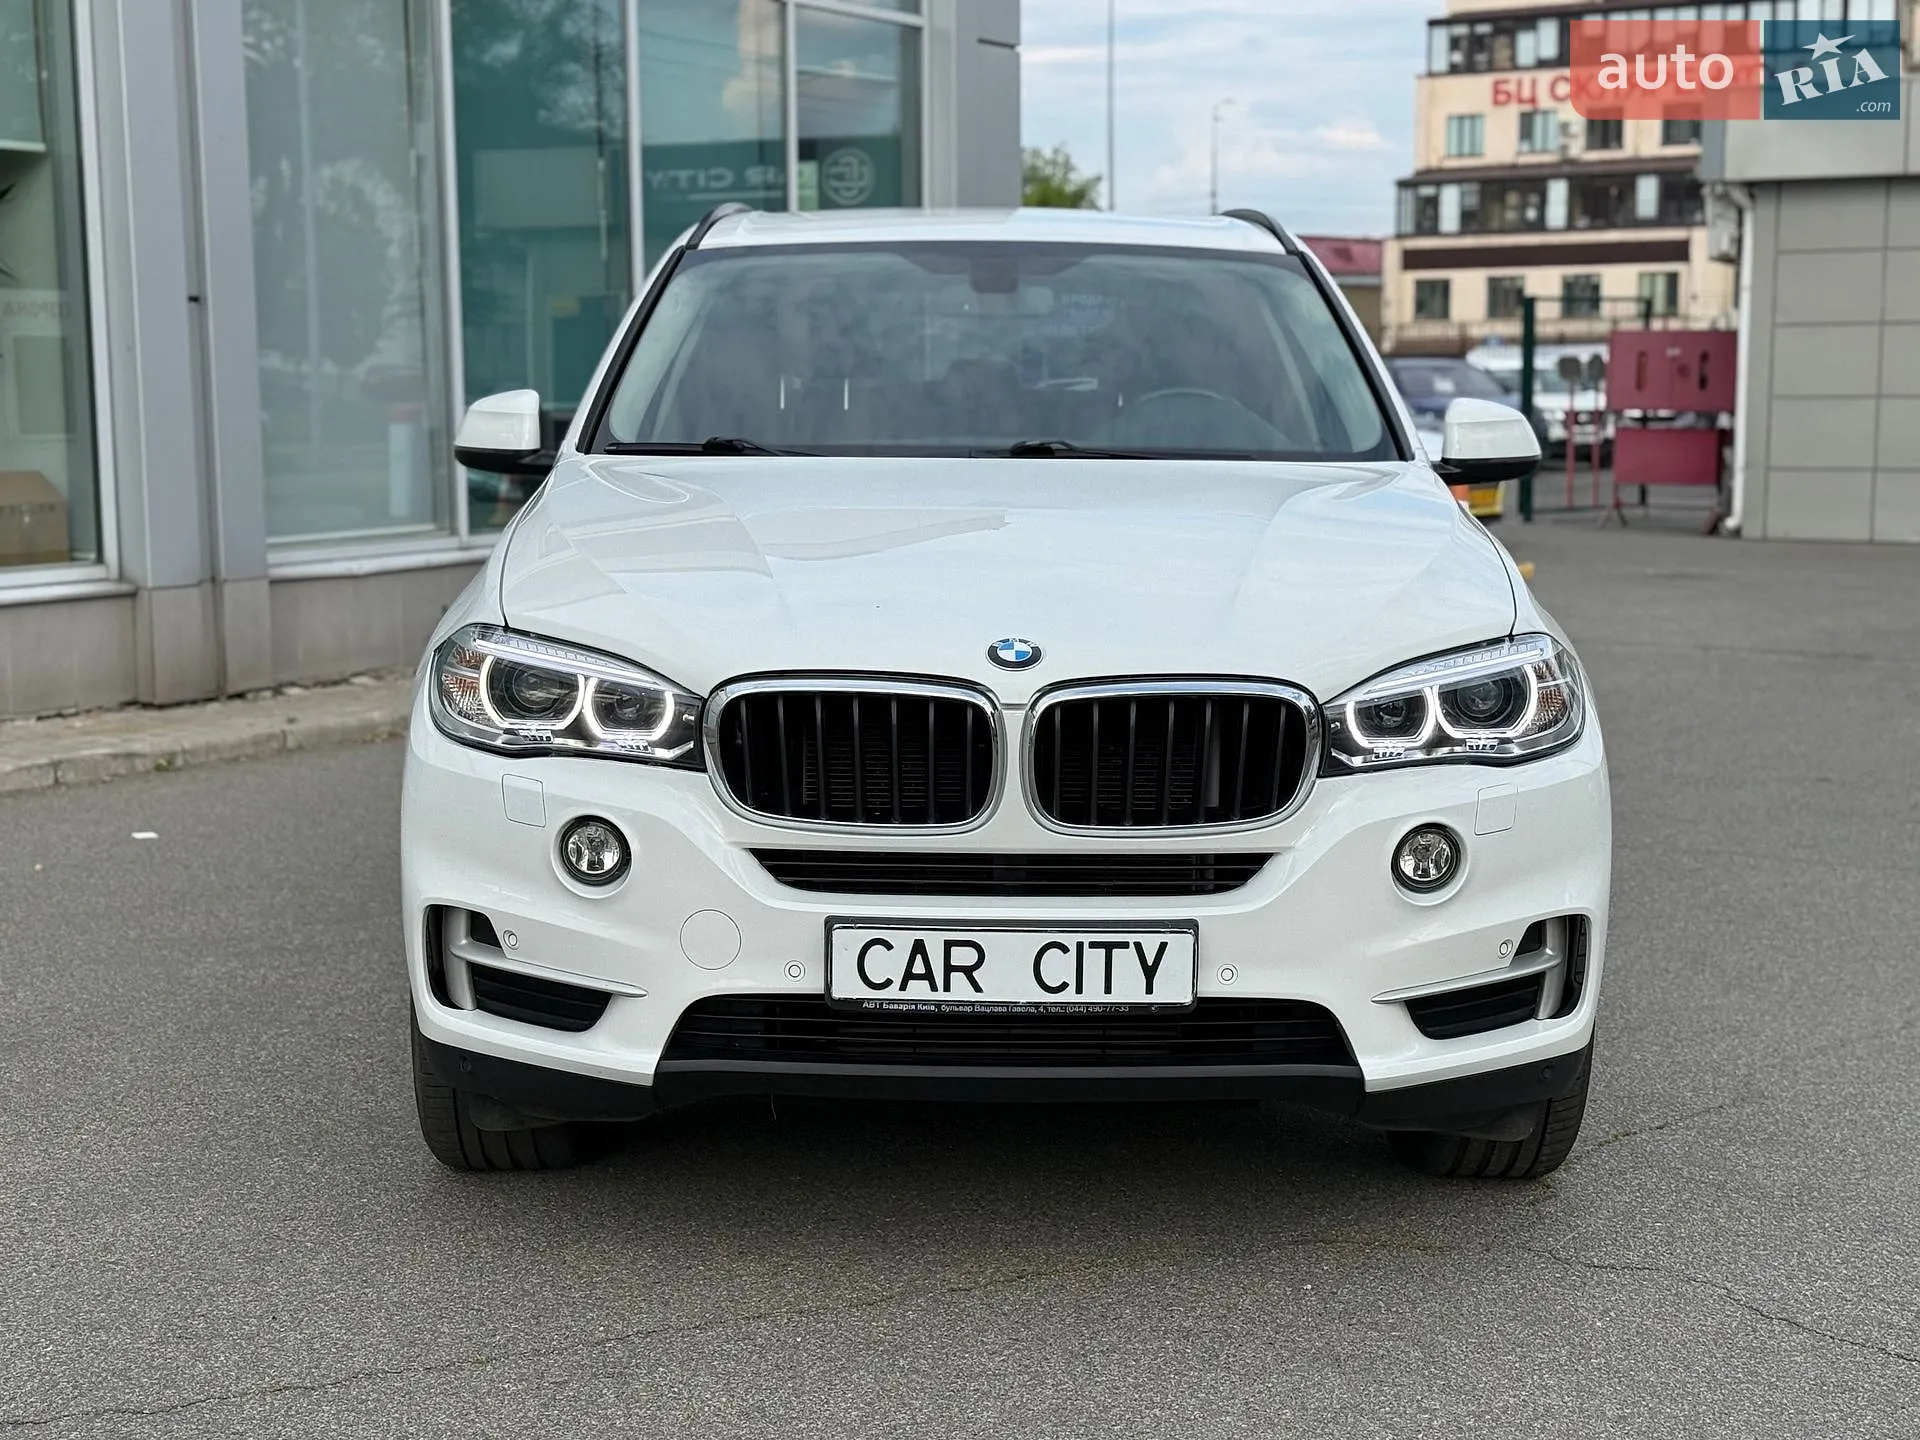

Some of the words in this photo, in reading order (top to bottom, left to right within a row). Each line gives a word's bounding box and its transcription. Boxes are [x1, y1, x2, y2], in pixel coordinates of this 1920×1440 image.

[1493, 77, 1537, 108] БЦ
[856, 937, 986, 993] CAR
[1033, 941, 1169, 995] CITY
[941, 1003, 973, 1013] бульвар
